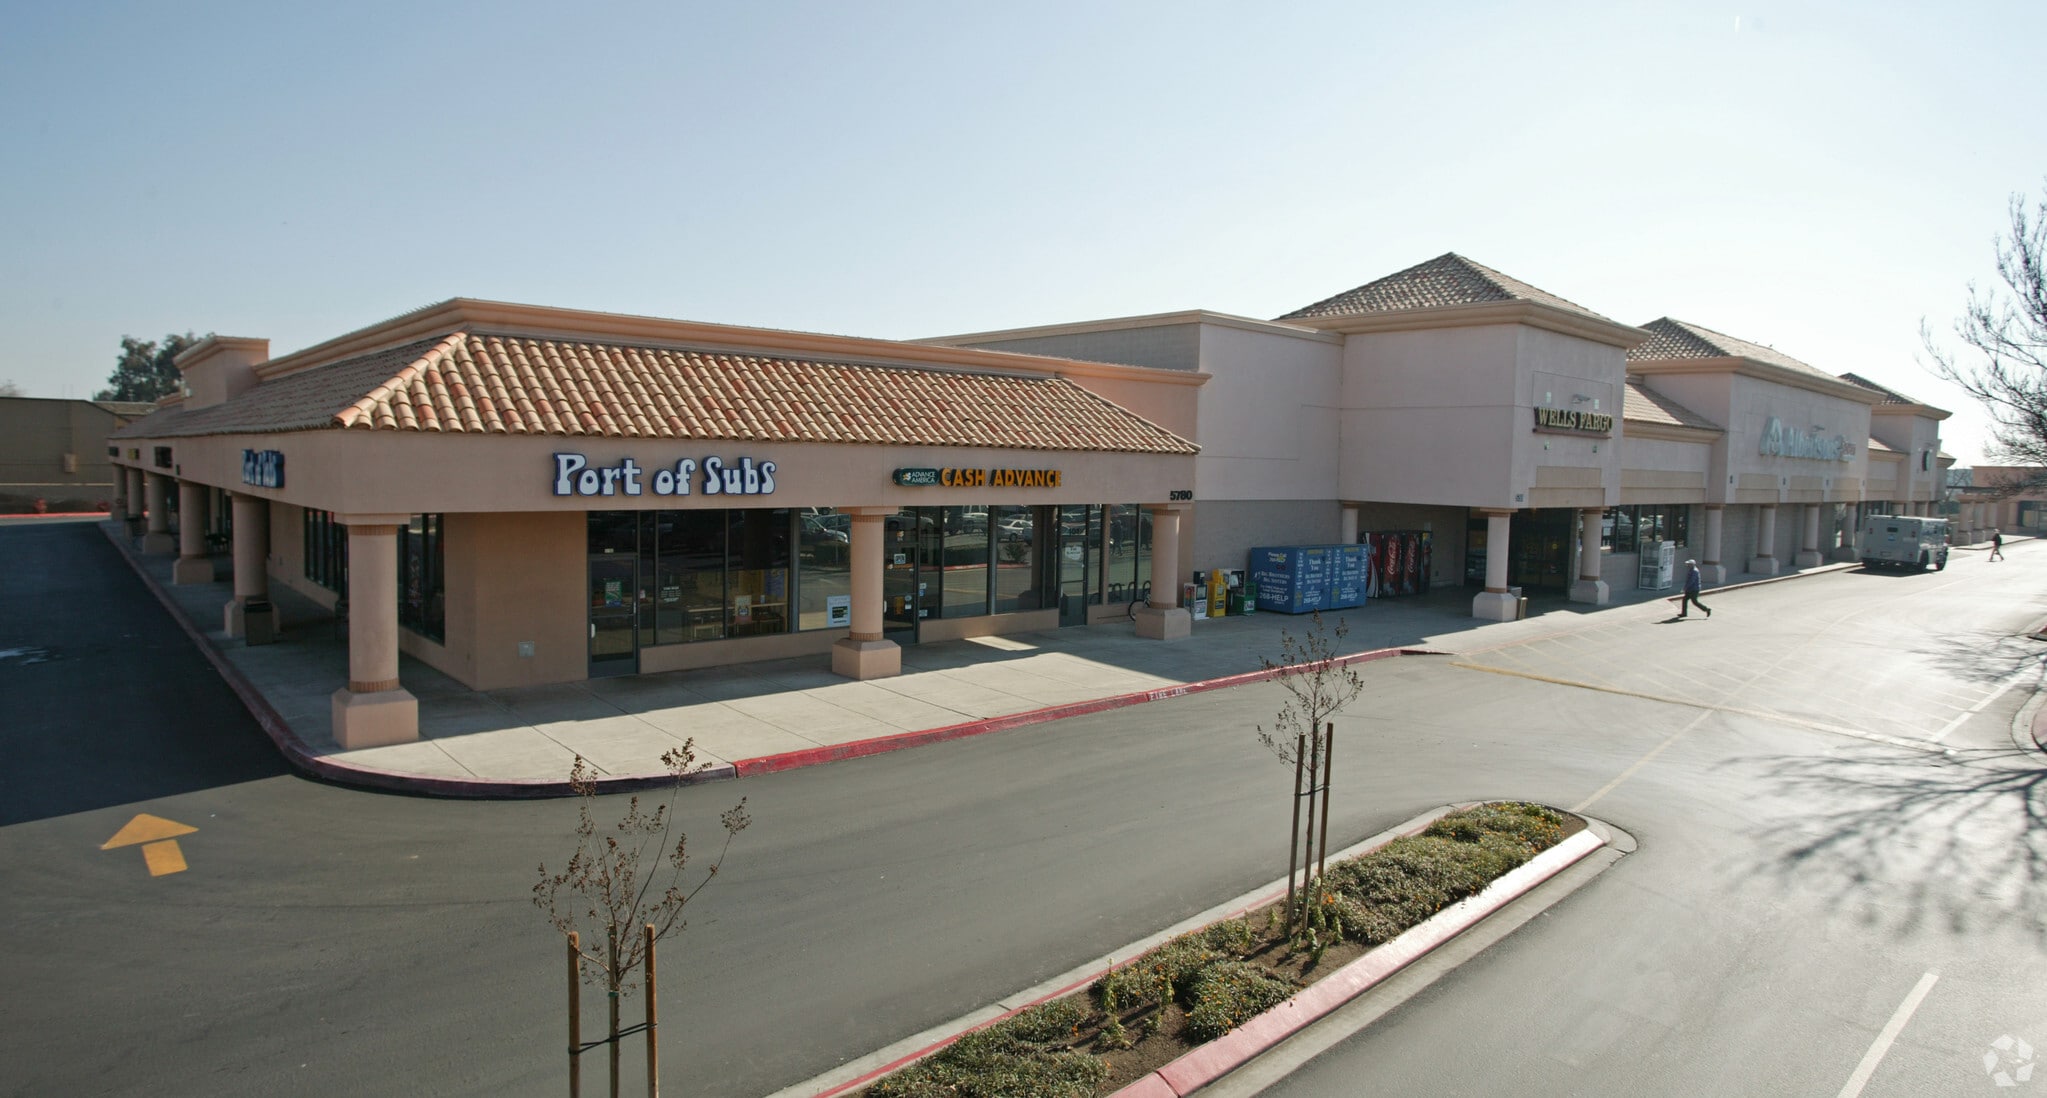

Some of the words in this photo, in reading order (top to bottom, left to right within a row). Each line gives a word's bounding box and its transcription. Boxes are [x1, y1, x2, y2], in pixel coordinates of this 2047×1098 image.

[1538, 407, 1577, 428] WELLS
[1580, 412, 1613, 432] FARGO
[553, 452, 642, 496] Port
[652, 458, 697, 496] of
[702, 456, 777, 496] Subs
[940, 468, 986, 487] CASH
[990, 469, 1062, 487] ADVANCE
